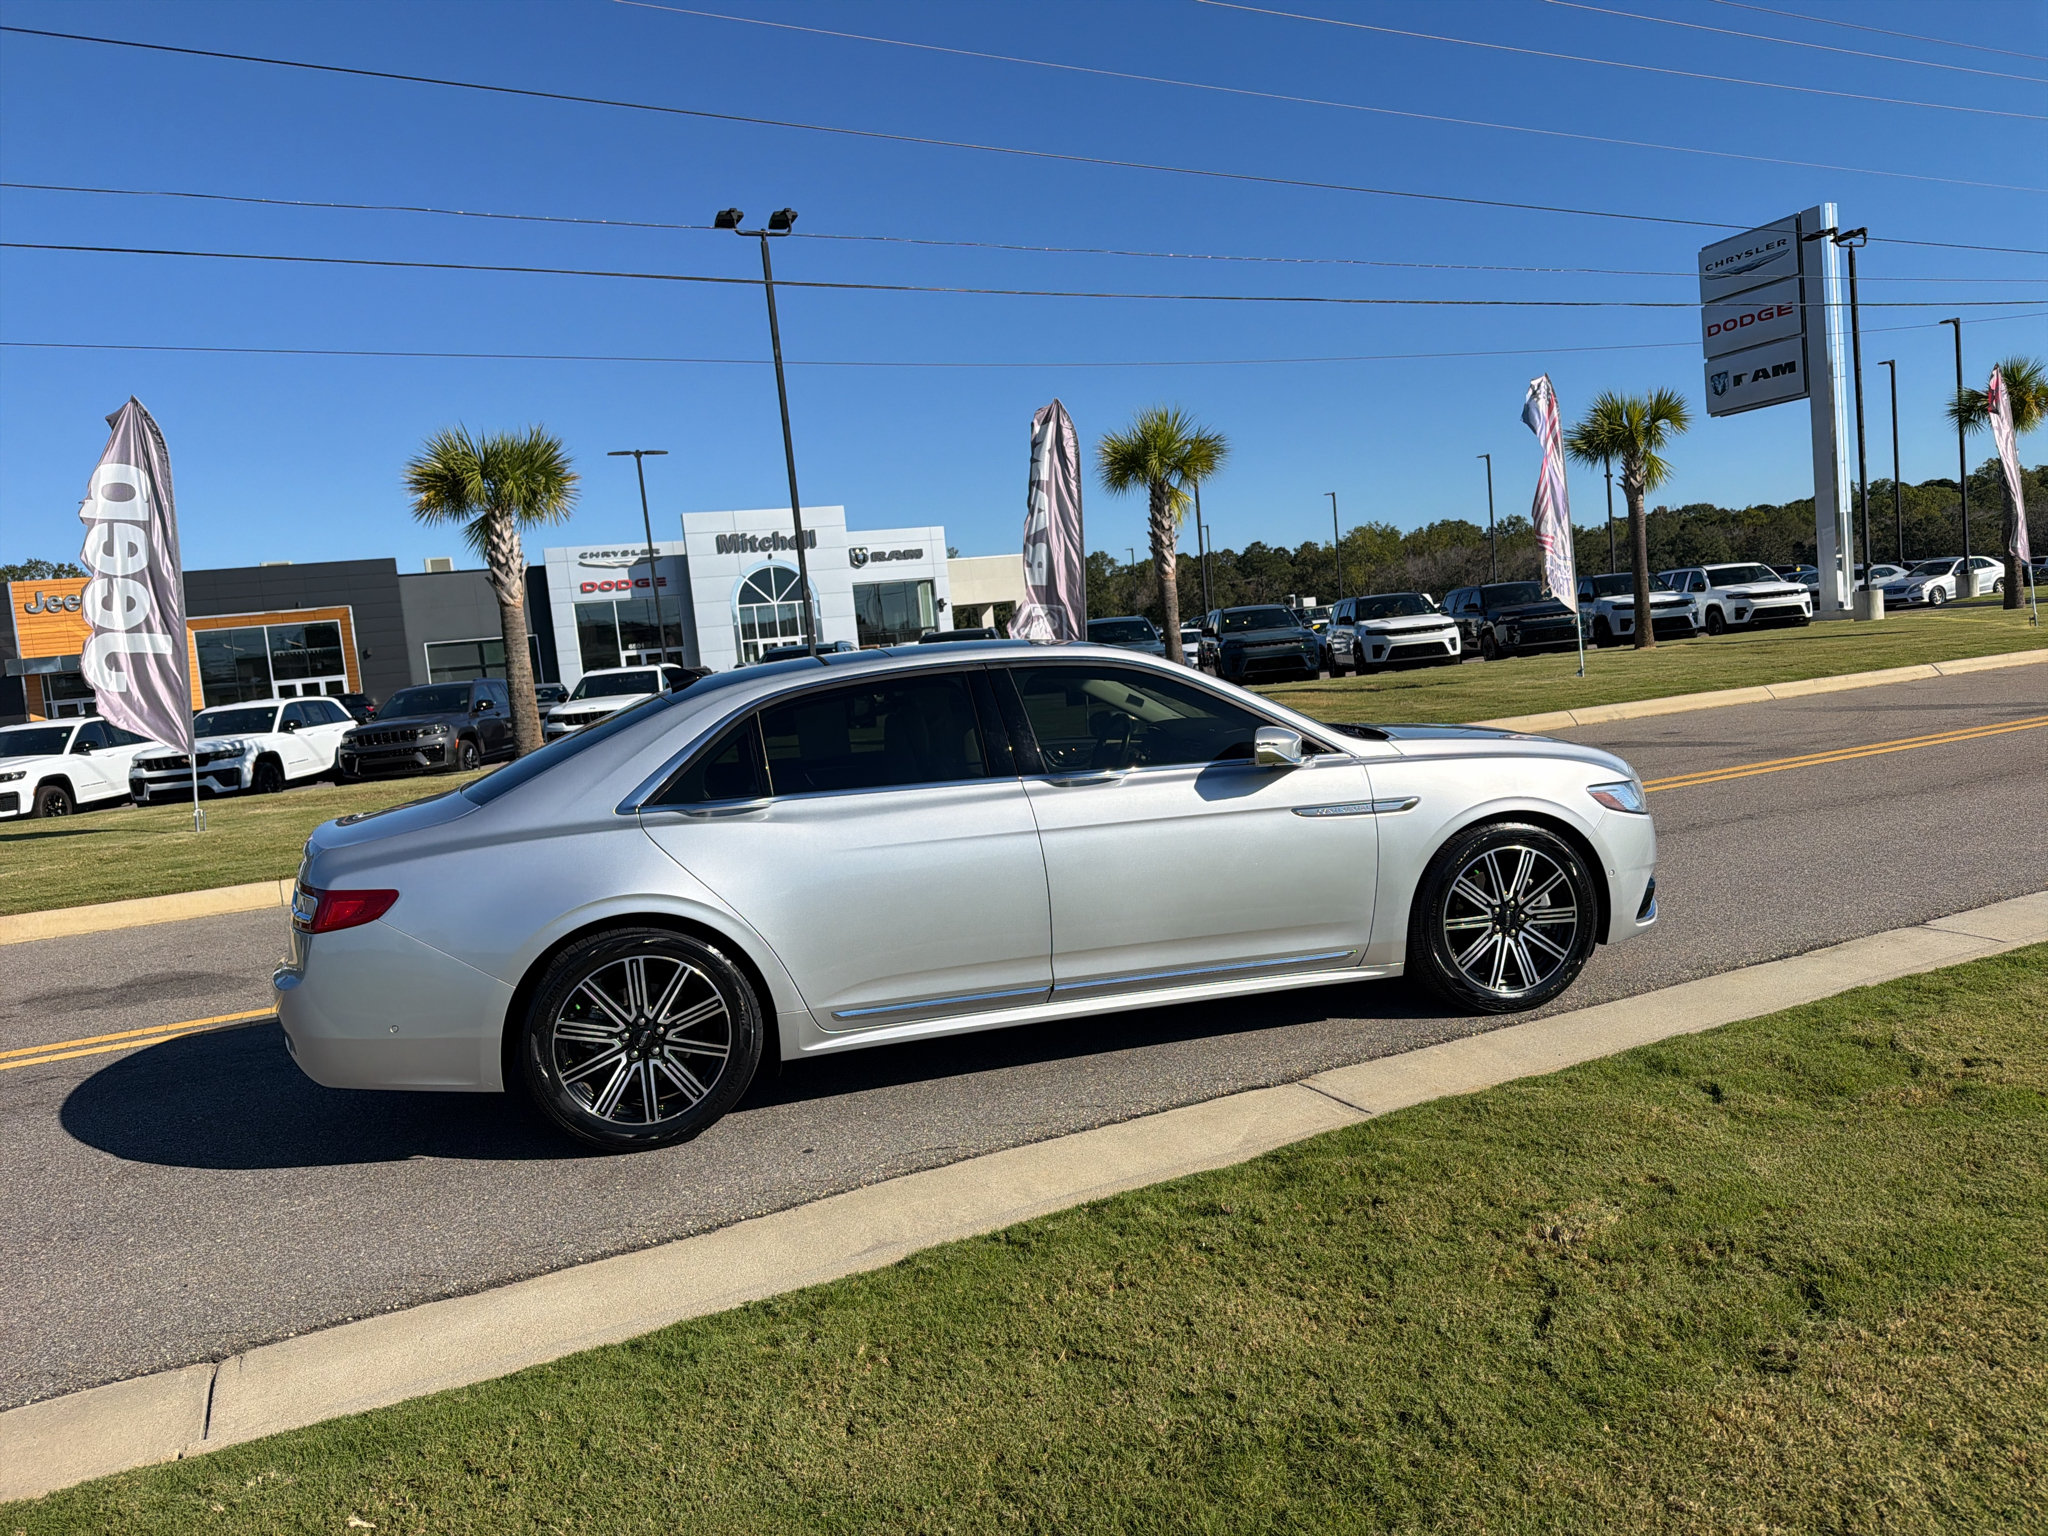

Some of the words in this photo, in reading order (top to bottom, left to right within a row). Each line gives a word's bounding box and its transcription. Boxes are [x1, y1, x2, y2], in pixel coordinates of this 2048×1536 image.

[1705, 238, 1788, 272] CHRYSLER
[1707, 301, 1793, 338] DODGE
[578, 548, 661, 559] CHRYSLER
[715, 529, 817, 554] Mitchell
[870, 548, 923, 563] RAM
[580, 577, 667, 594] DODGE
[24, 590, 81, 614] Jee
